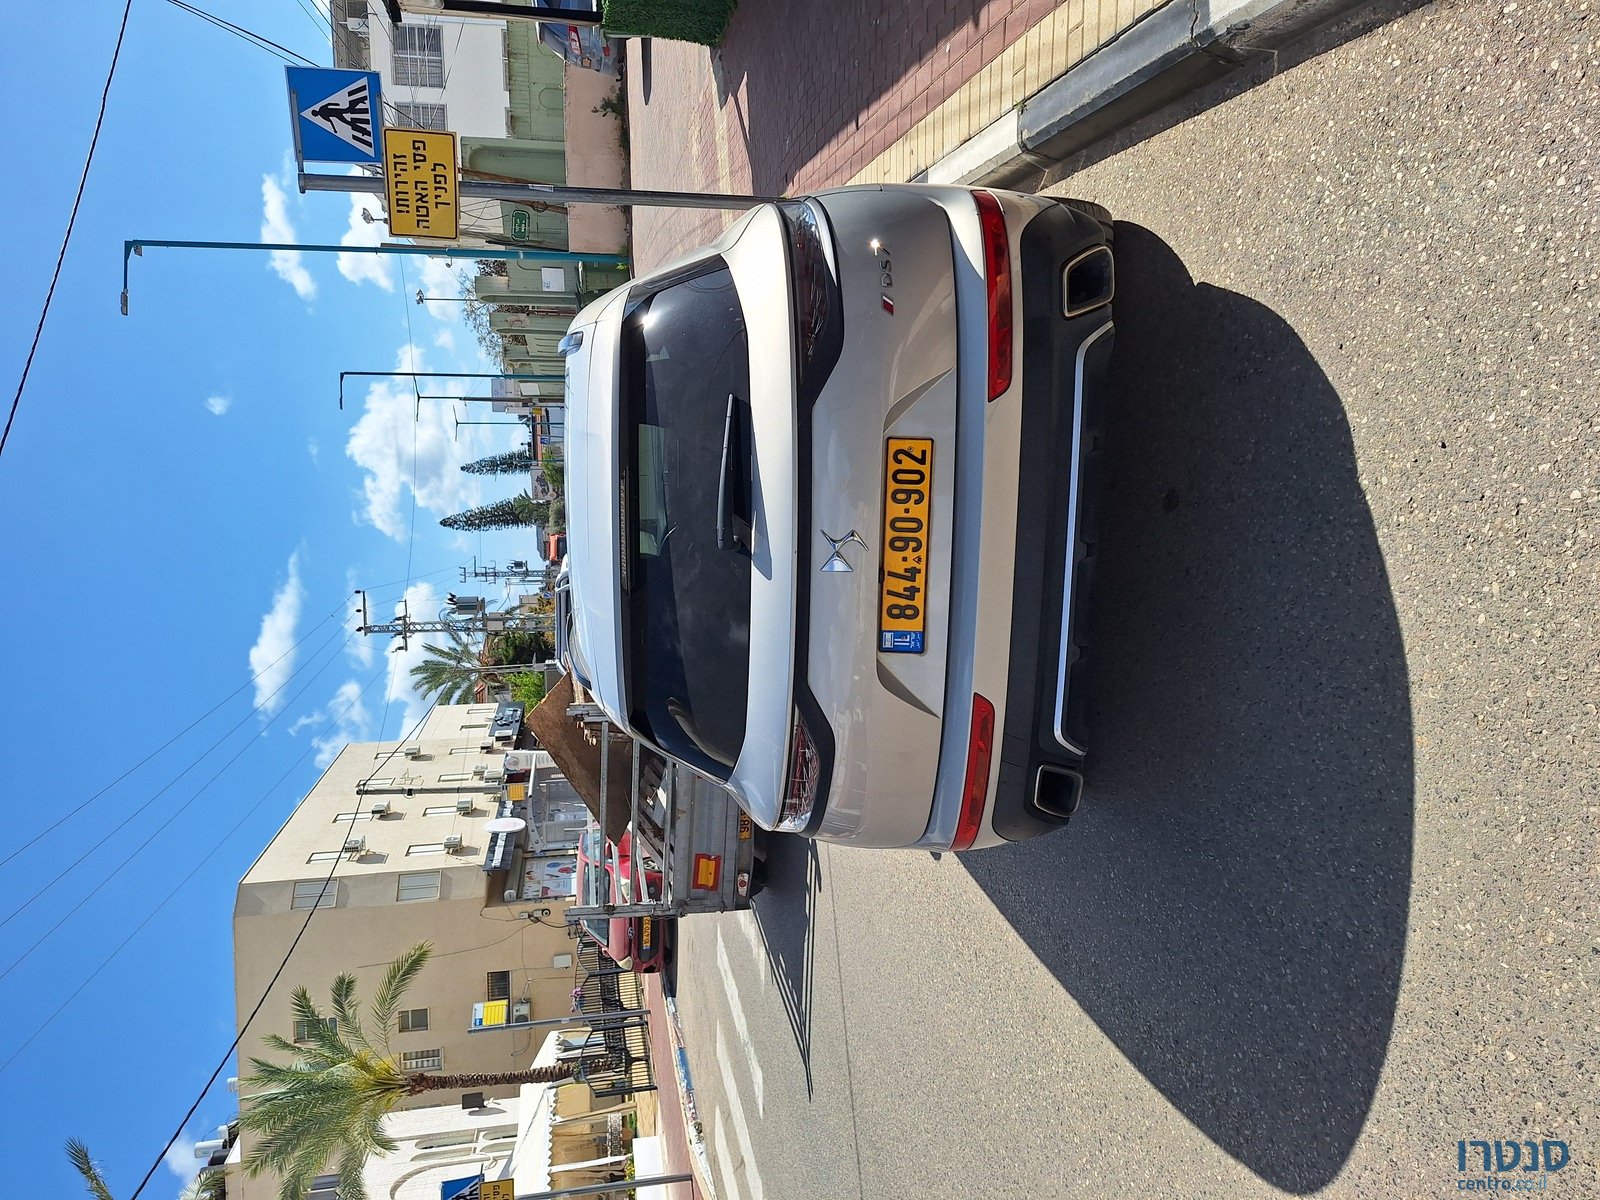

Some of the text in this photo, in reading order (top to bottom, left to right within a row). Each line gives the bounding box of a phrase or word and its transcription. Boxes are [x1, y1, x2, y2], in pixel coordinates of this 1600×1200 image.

[393, 153, 410, 214] זהירות!
[412, 140, 430, 229] פסי האטה
[430, 162, 450, 209] לפניך
[886, 448, 927, 621] 844-90-902
[894, 634, 910, 646] IL
